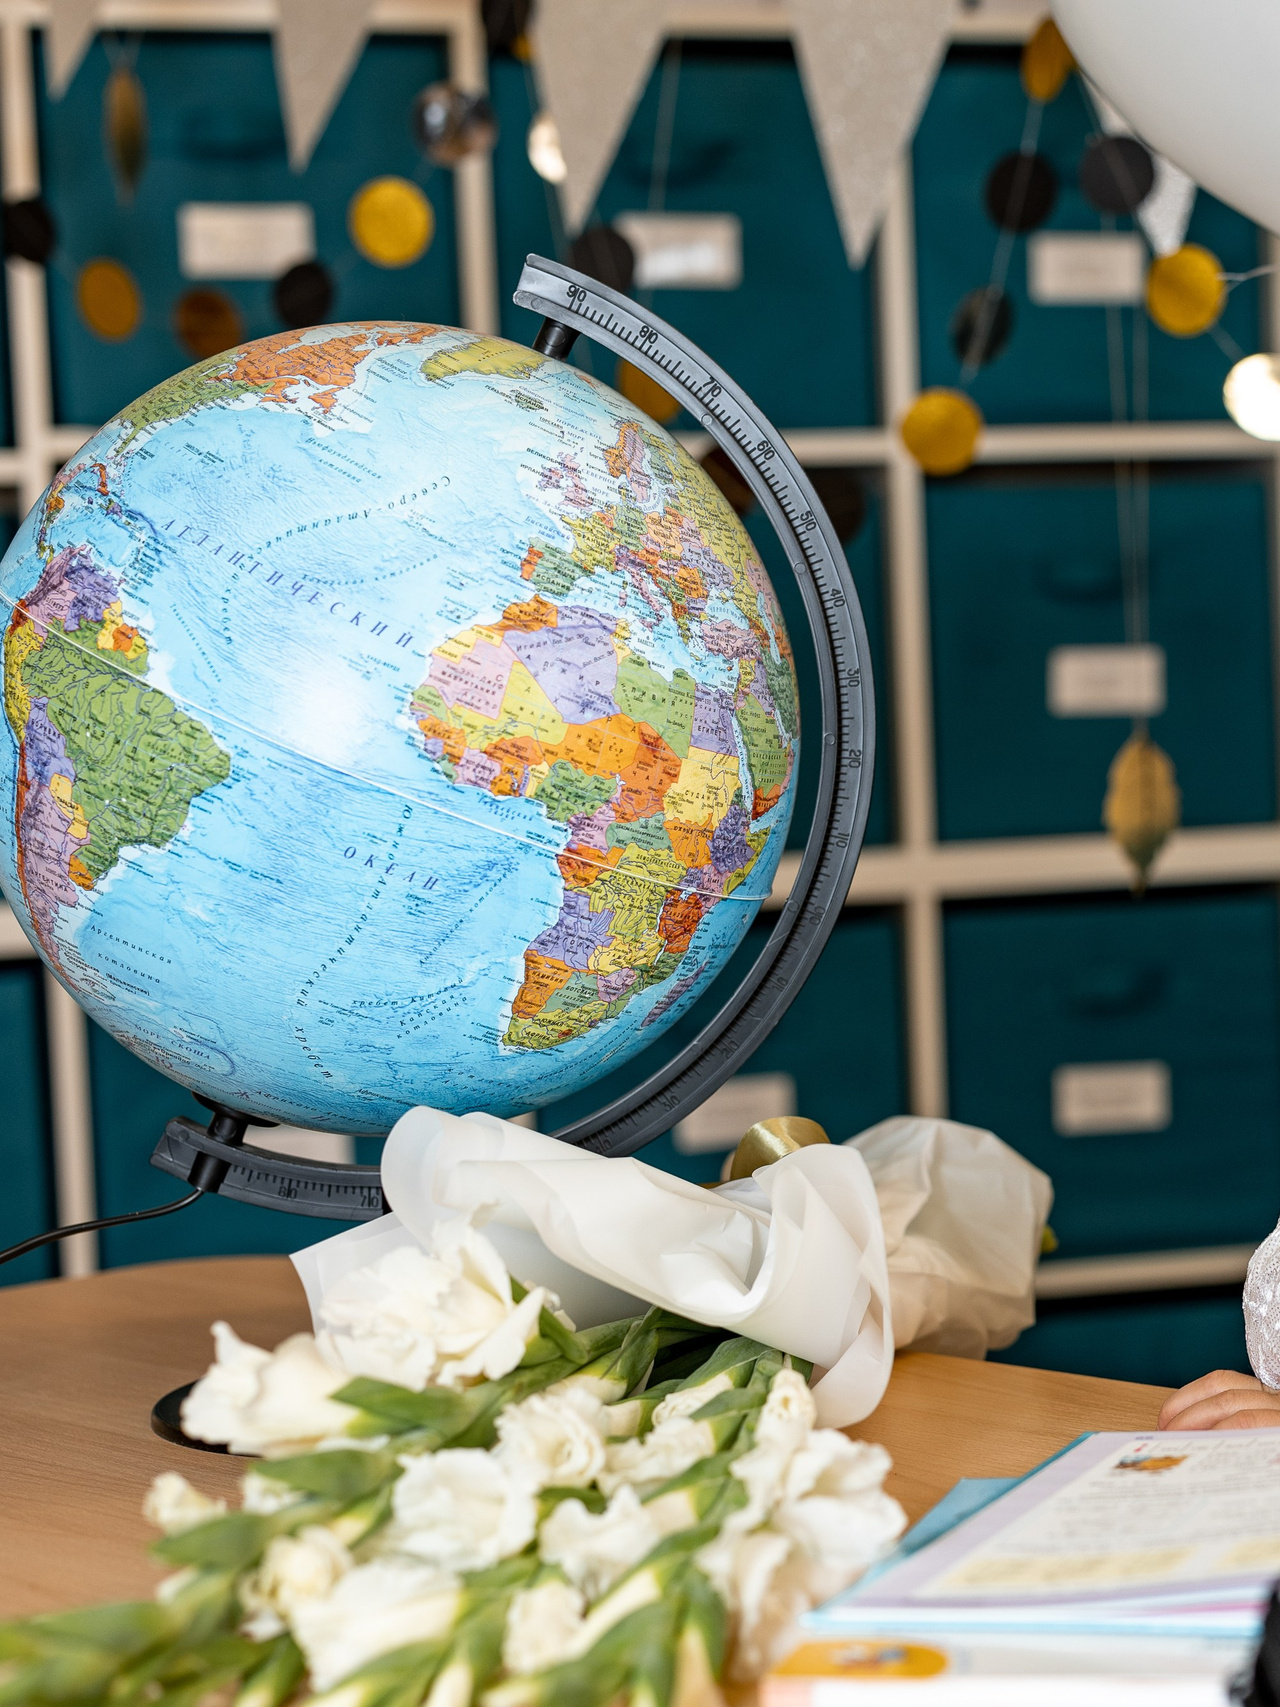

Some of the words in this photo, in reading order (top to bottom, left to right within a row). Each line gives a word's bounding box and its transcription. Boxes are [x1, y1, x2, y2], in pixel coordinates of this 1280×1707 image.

[566, 284, 587, 303] 90
[639, 325, 659, 345] 80
[702, 376, 722, 398] 70
[756, 439, 775, 461] 60
[799, 510, 818, 531] 50
[161, 519, 415, 648] АТЛАНТИЧЕСКИЙ
[830, 588, 846, 608] 40
[847, 667, 861, 688] 30
[848, 749, 862, 769] 20
[835, 832, 850, 849] 10
[343, 846, 440, 890] ОКЕАН
[90, 924, 172, 964] Аргентинская
[98, 952, 160, 984] котловина
[772, 976, 789, 992] 10
[294, 1026, 333, 1079] хребет
[720, 1039, 740, 1060] 20
[663, 1095, 681, 1112] 30
[278, 1181, 298, 1200] 80
[360, 1195, 379, 1209] 70
